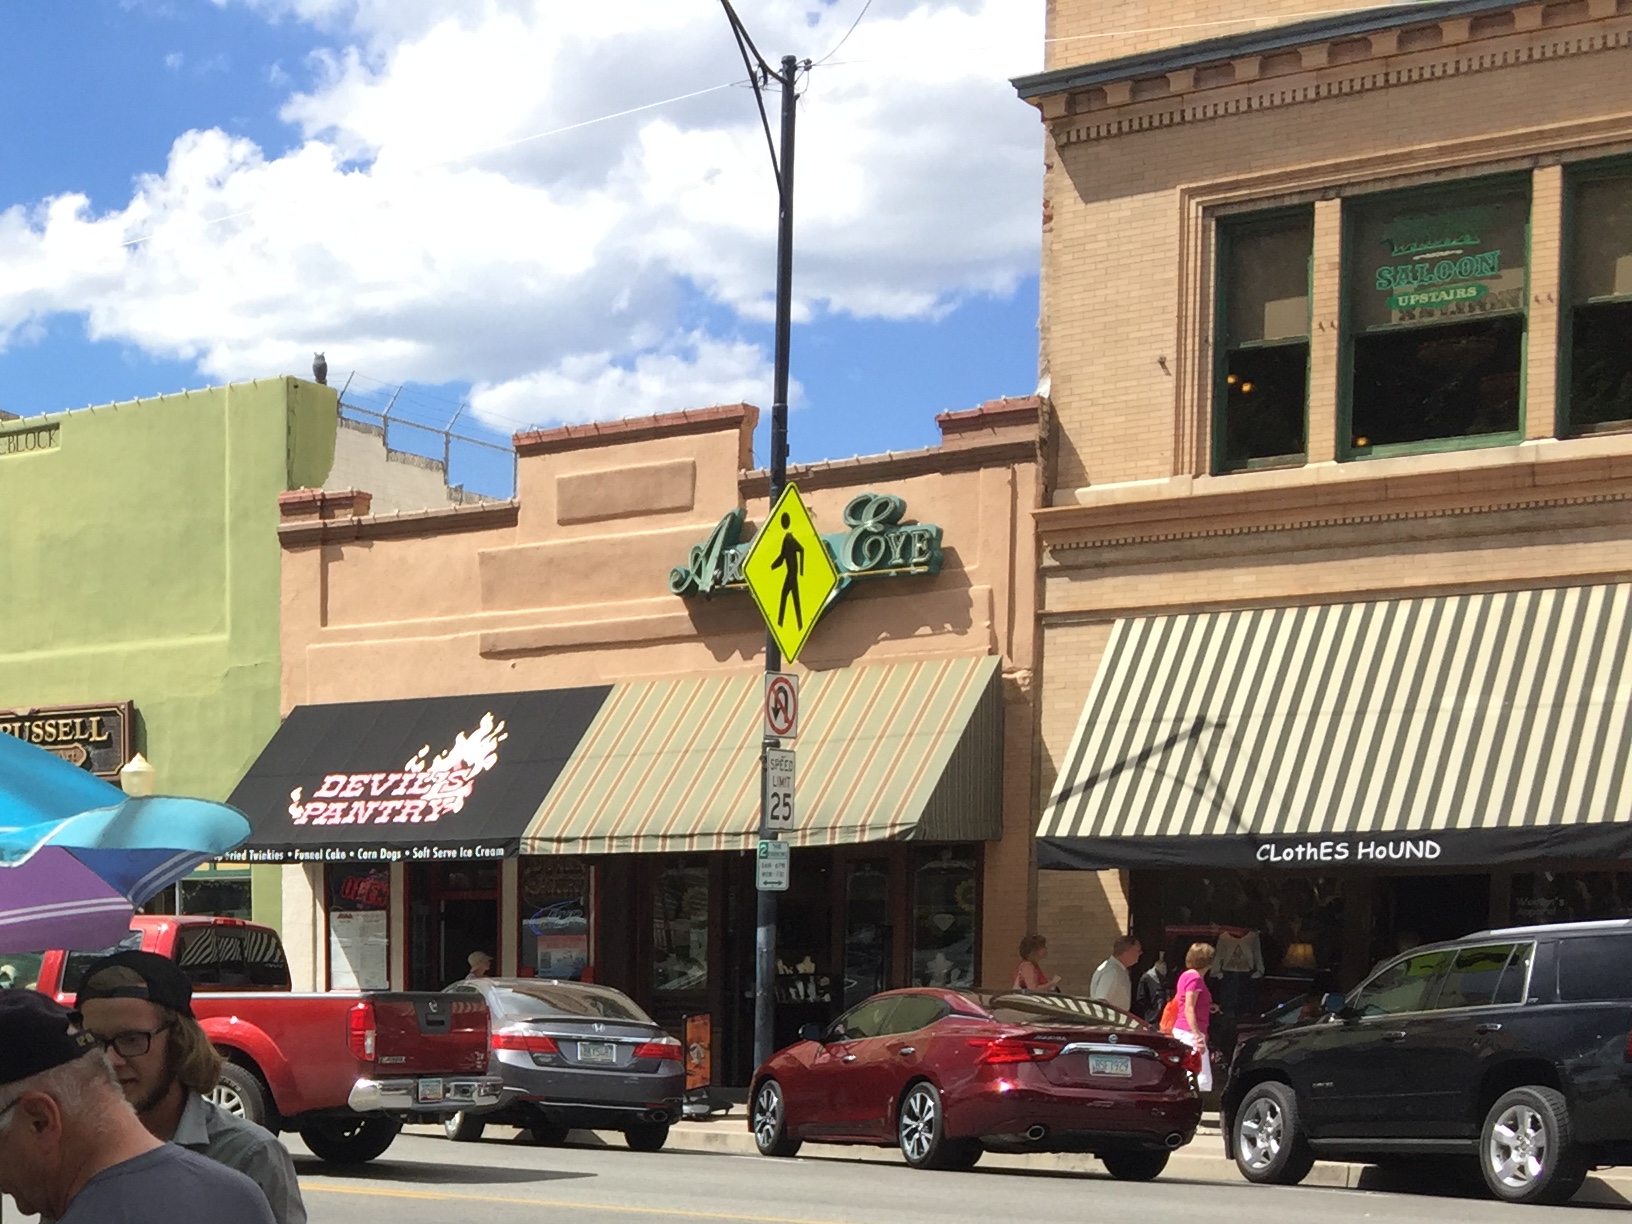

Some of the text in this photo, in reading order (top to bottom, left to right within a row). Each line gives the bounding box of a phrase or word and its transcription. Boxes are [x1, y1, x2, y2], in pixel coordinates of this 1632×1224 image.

[1376, 250, 1500, 290] SALOON
[1397, 287, 1478, 307] UPSTAIRS
[770, 758, 794, 772] SPEED
[772, 776, 792, 788] LIMIT
[293, 799, 453, 826] PANTRY
[770, 791, 792, 822] 25
[249, 848, 284, 861] Twinkies
[294, 847, 324, 860] Funnel
[325, 847, 347, 860] Cake
[357, 847, 378, 860] Corn
[379, 847, 402, 862] Dogs
[412, 846, 430, 859] Soft
[432, 846, 457, 859] Serve
[459, 846, 473, 858] Ice
[474, 845, 505, 858] Cream
